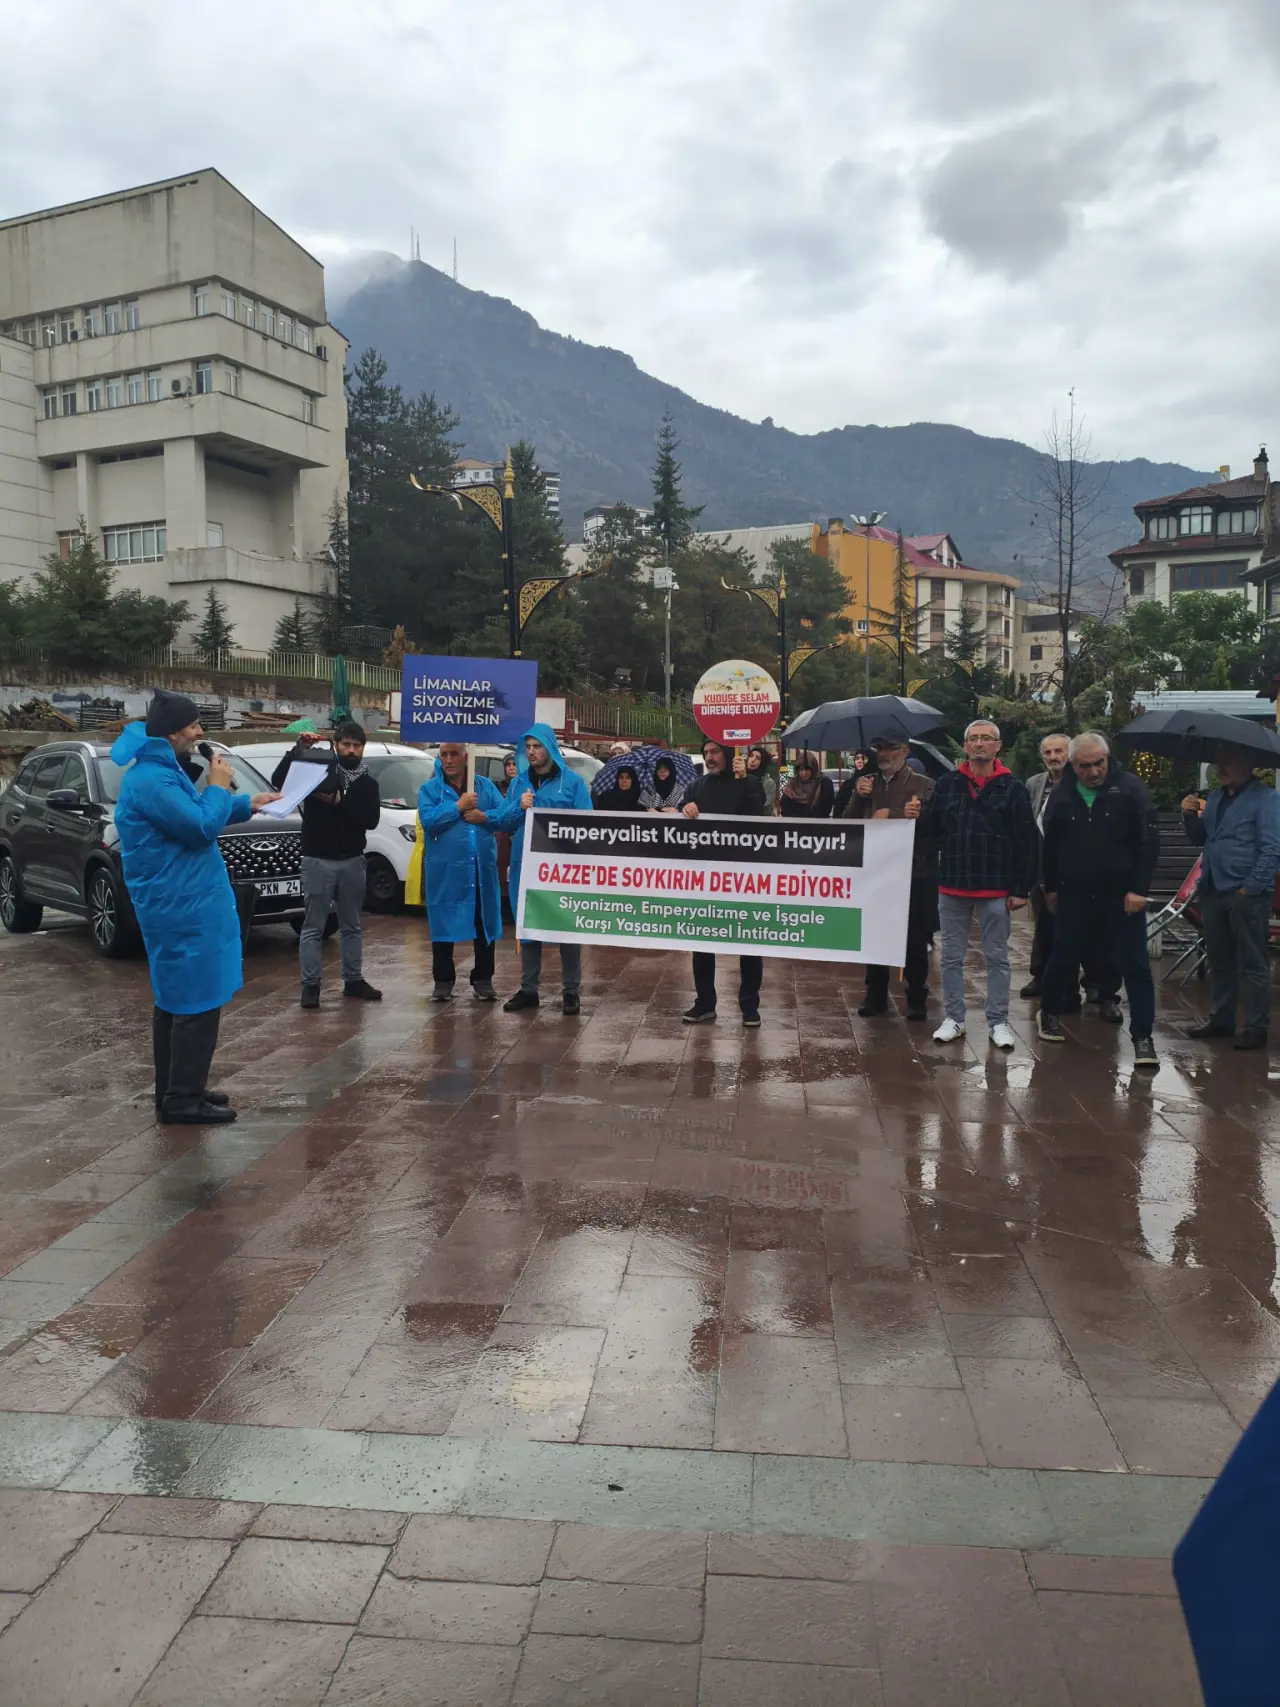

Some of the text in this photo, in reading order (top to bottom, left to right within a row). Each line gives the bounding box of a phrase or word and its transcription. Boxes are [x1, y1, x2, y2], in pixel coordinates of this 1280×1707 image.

[414, 675, 491, 692] LİMANLAR
[413, 692, 495, 709] SİYONİZME
[741, 693, 769, 702] SELAM
[412, 711, 500, 726] KAPATILSIN
[701, 704, 773, 716] DİRENİŞE DEVAM
[548, 821, 846, 854] Emperyalist Kuşatmaya Hayır!
[622, 867, 705, 892] SOYKIRIM
[709, 871, 771, 895] DEVAM
[776, 869, 852, 899] EDİYOR!
[559, 896, 825, 927] Siyonizme, Emperyalizme ve İşgale
[575, 915, 805, 943] Karşı Yaşasın Küresel İntifada!
